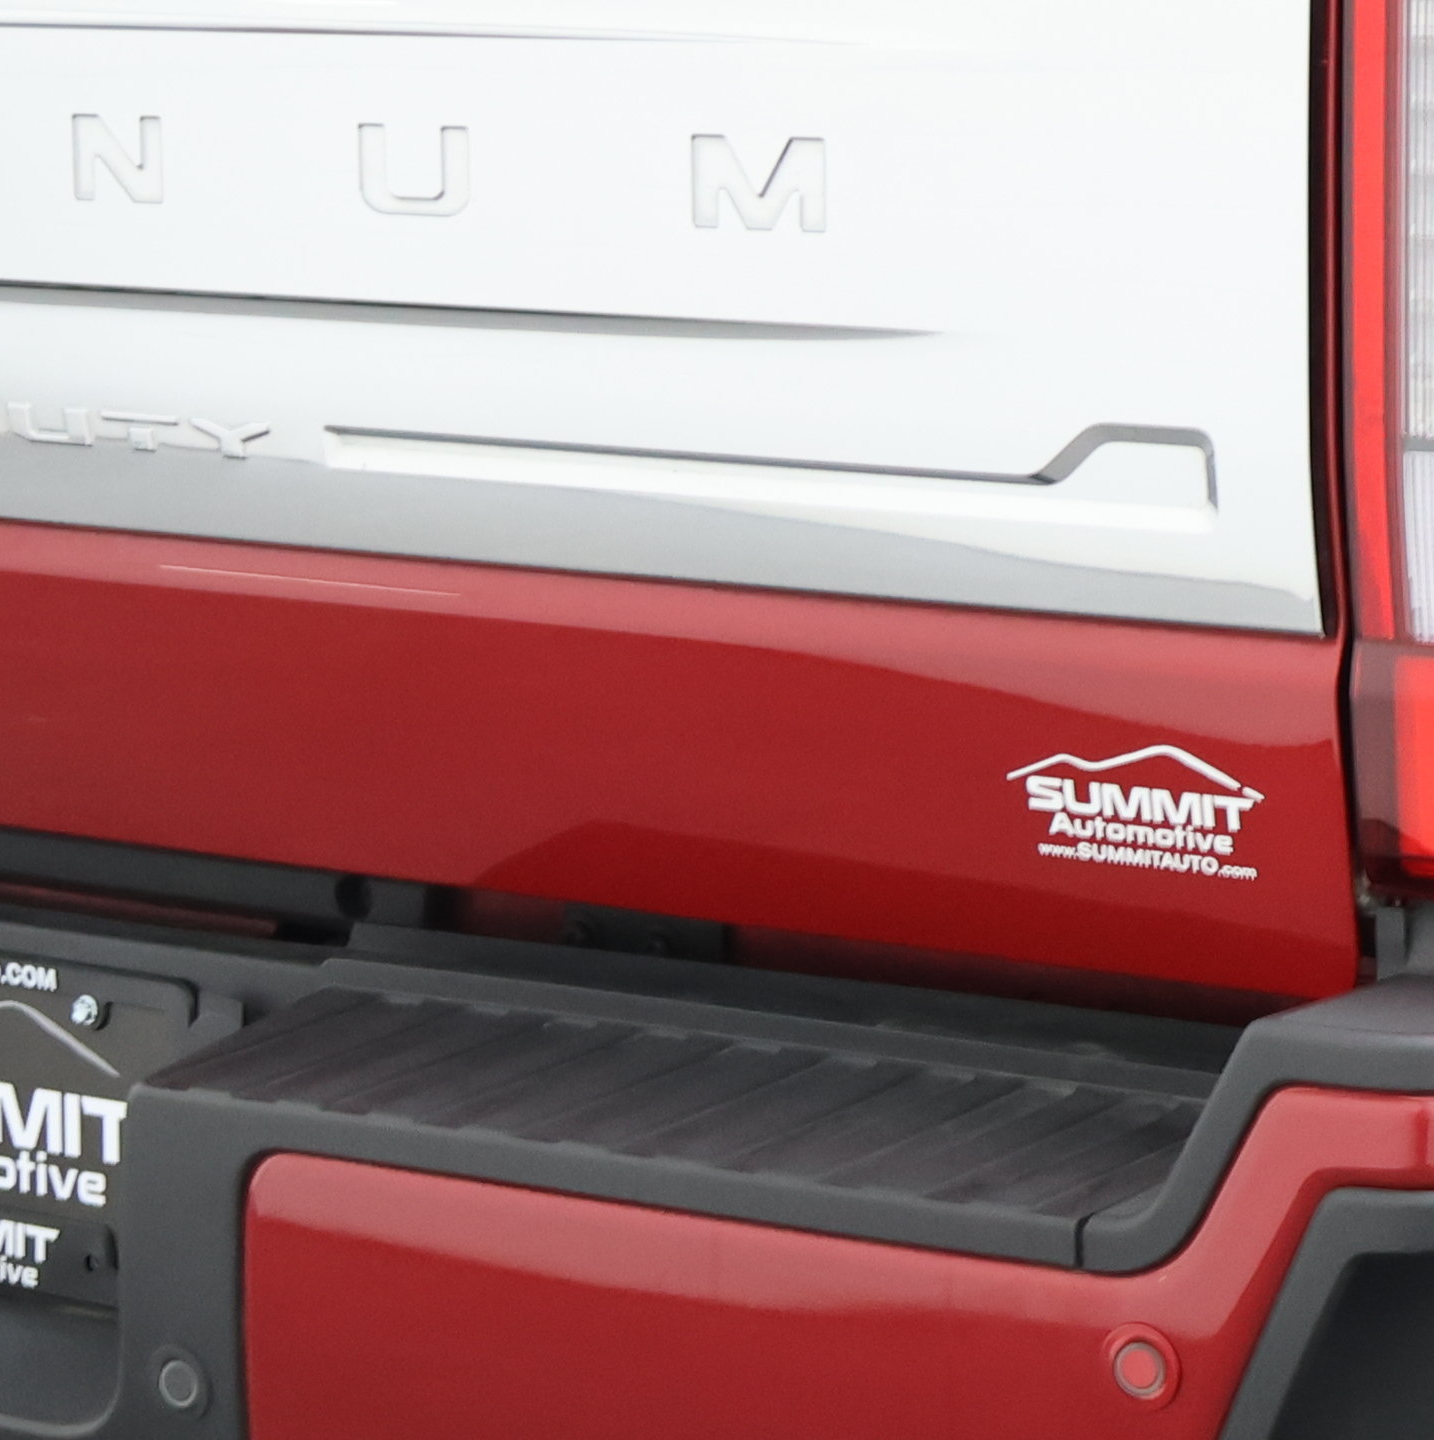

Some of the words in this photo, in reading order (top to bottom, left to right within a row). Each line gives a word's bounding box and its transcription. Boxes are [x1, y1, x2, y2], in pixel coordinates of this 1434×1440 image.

[1025, 774, 1256, 833] SUMMIT
[1048, 811, 1235, 855] Automotive
[1037, 841, 1259, 881] www.SUMMITAUTO.com
